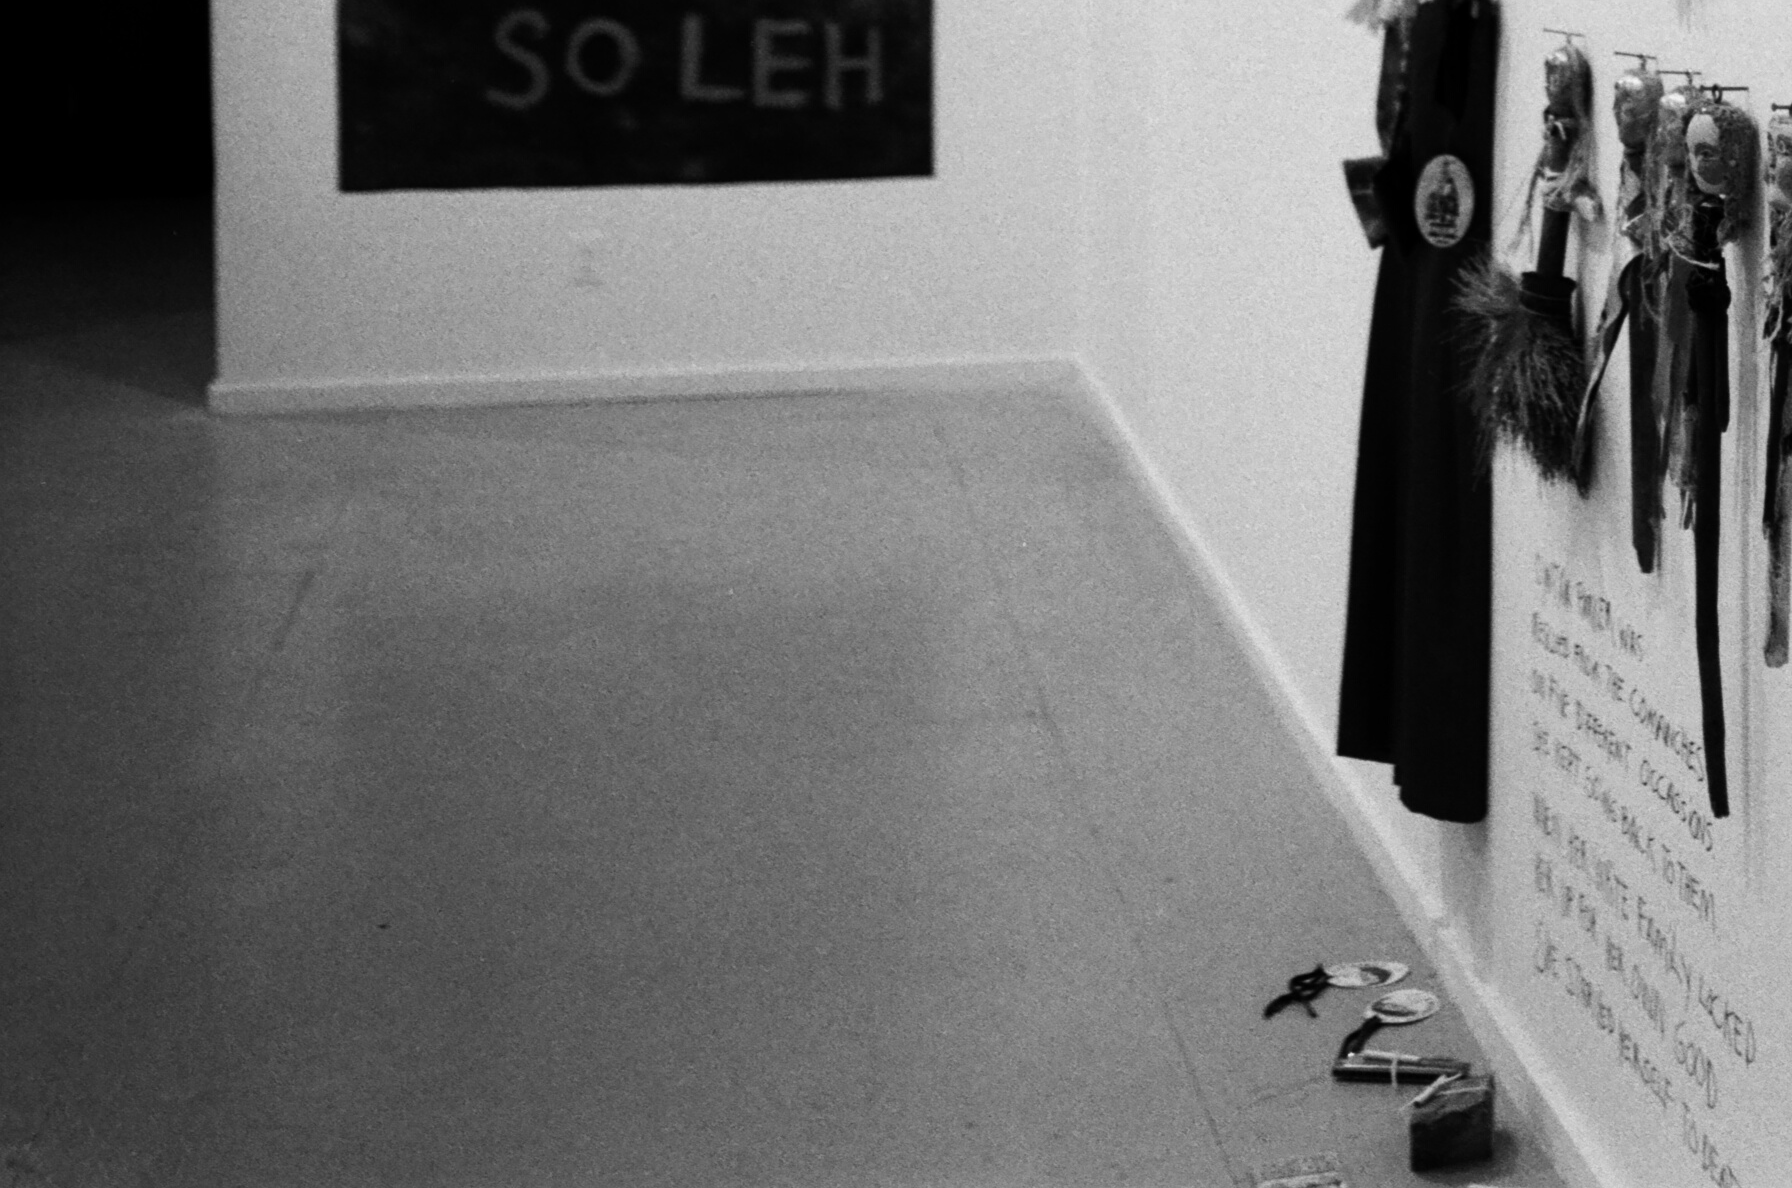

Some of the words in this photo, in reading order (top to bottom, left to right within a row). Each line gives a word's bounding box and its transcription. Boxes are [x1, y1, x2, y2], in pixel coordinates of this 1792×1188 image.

[485, 8, 640, 110] SO
[680, 13, 884, 110] LEH
[1674, 1020, 1718, 1110] GOOD
